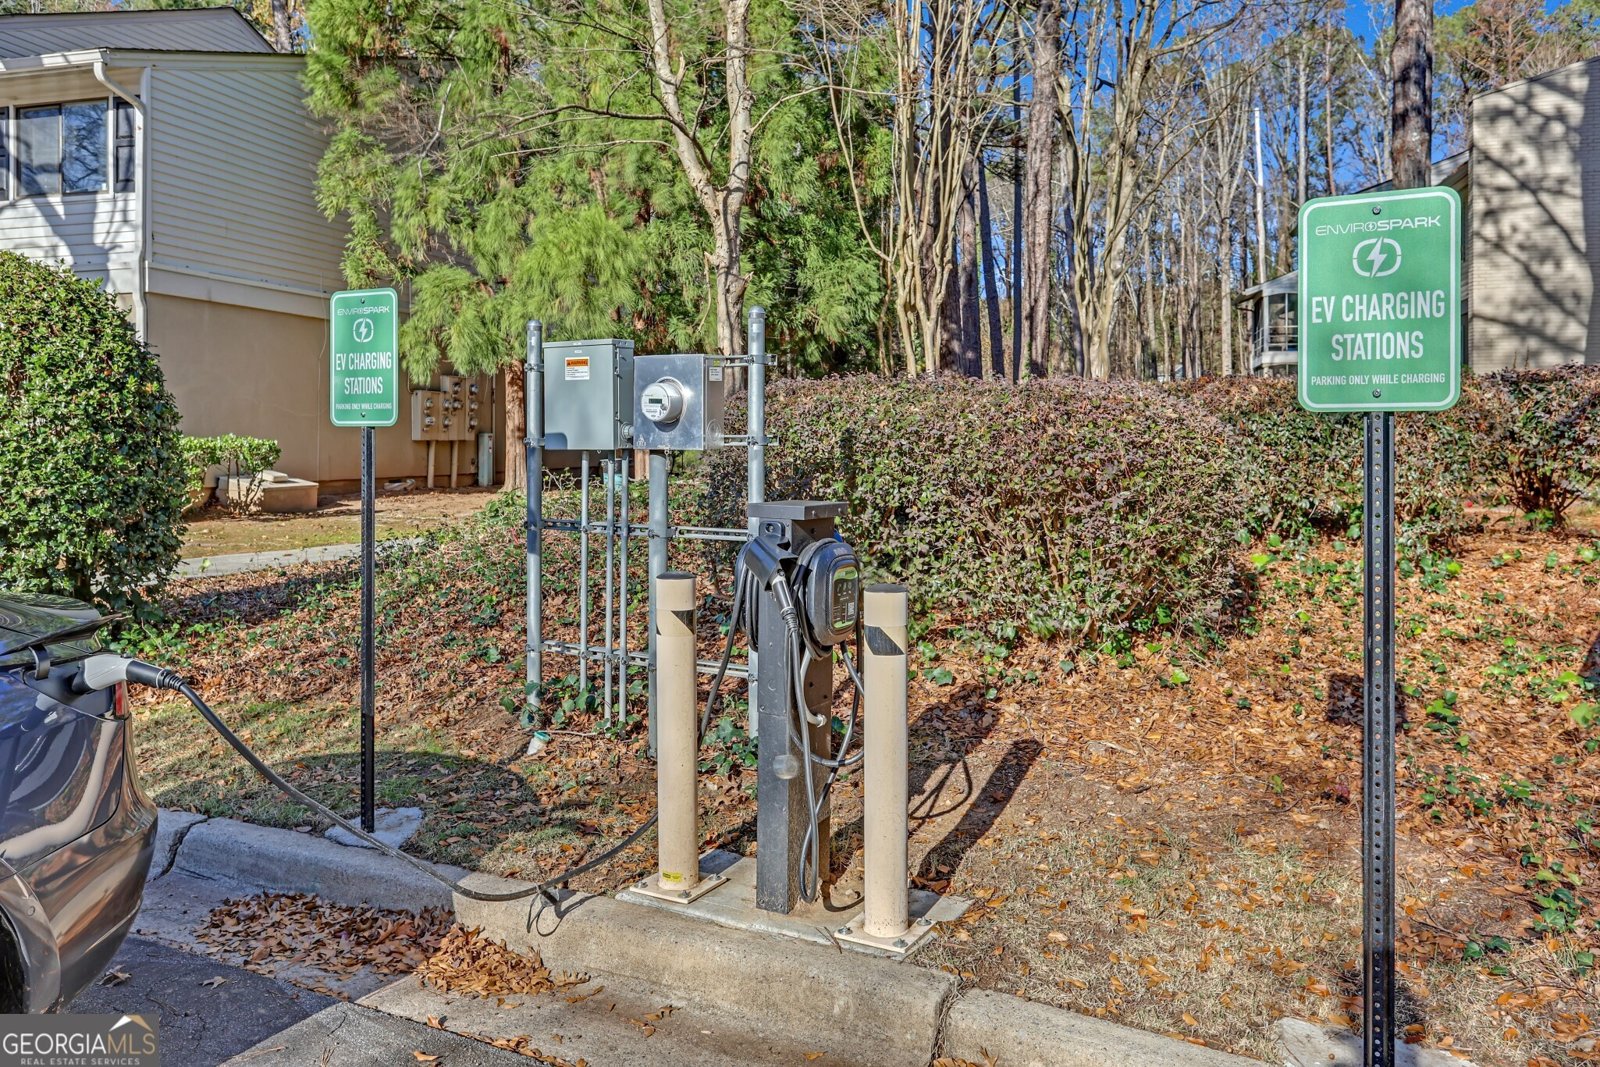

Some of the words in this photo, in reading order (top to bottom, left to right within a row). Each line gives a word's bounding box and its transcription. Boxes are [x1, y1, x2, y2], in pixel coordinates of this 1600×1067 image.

[1315, 215, 1441, 236] ENVIROSPARK
[1311, 296, 1336, 323] EV
[1341, 290, 1445, 322] CHARGING
[1331, 331, 1424, 361] STATIONS
[336, 353, 347, 371] EV
[348, 352, 392, 370] CHARGING
[344, 377, 383, 395] STATIONS
[1311, 375, 1347, 386] PARKING
[1349, 374, 1369, 385] ONLY
[1371, 373, 1399, 385] WHILE
[1401, 373, 1446, 384] CHARGING
